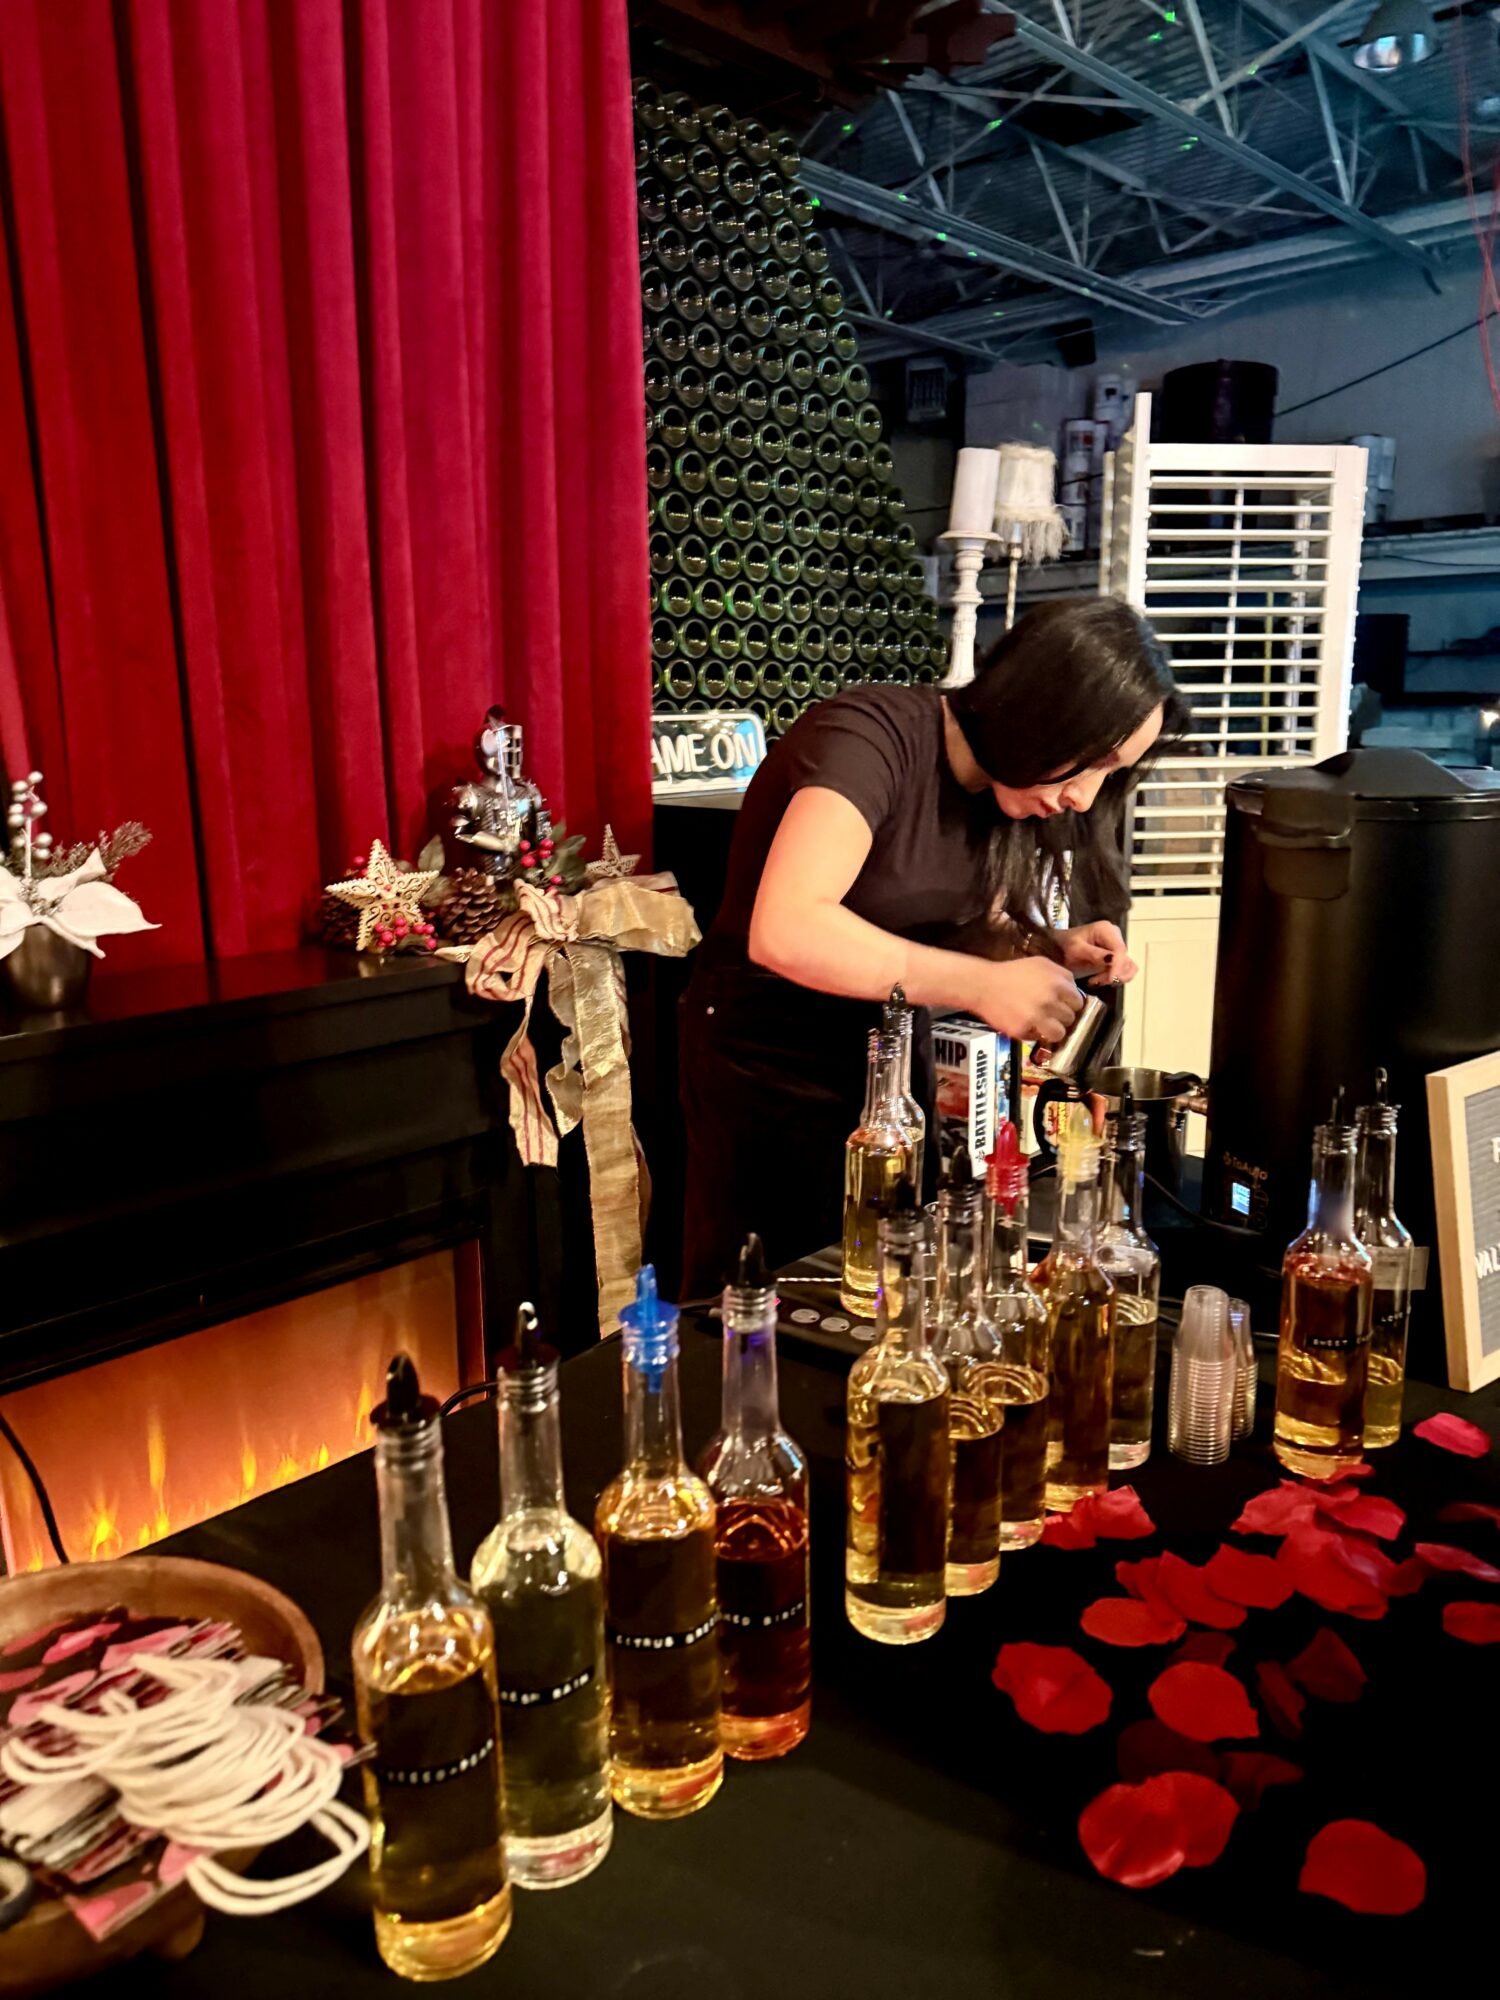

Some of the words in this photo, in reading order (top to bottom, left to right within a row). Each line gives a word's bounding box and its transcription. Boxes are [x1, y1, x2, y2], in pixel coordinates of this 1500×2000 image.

[710, 732, 757, 770] ON
[975, 1049, 989, 1150] BATTLESHIP
[615, 1634, 675, 1650] CITRUS
